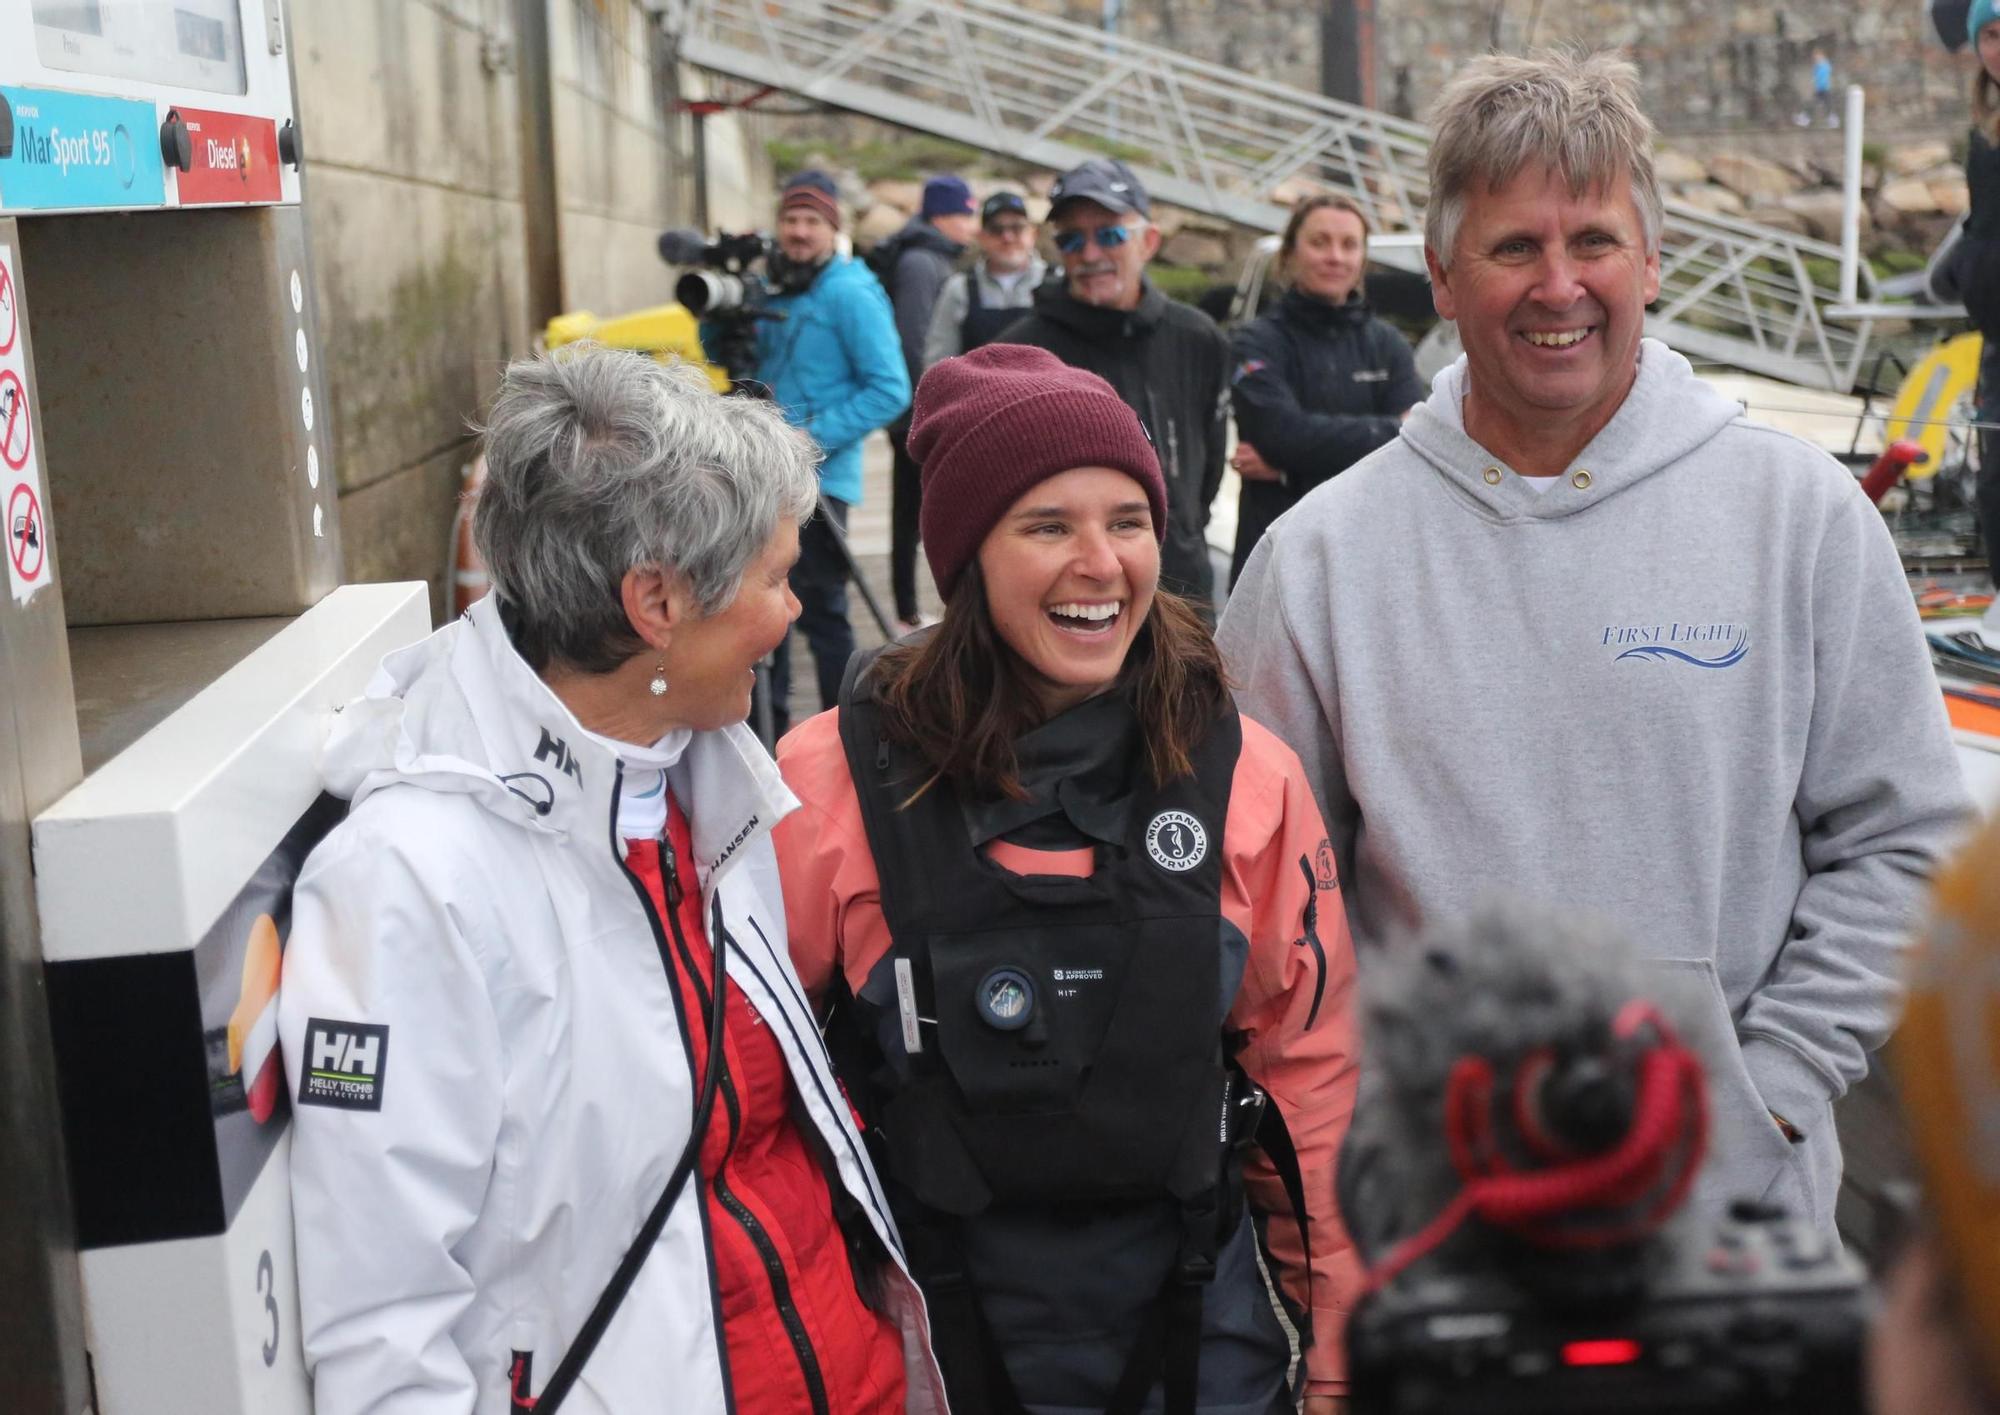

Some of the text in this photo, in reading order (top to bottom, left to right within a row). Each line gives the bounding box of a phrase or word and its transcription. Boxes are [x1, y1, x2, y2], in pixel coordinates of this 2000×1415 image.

[20, 126, 111, 176] MarSport 95
[207, 138, 238, 169] Diesel
[1602, 623, 1737, 645] FIRST LIGHT
[1148, 813, 1201, 840] MUSTANG
[711, 815, 760, 874] HANSEN
[1151, 840, 1205, 869] SURVIVAL
[309, 1078, 339, 1090] HELLY
[257, 1249, 280, 1369] 3
